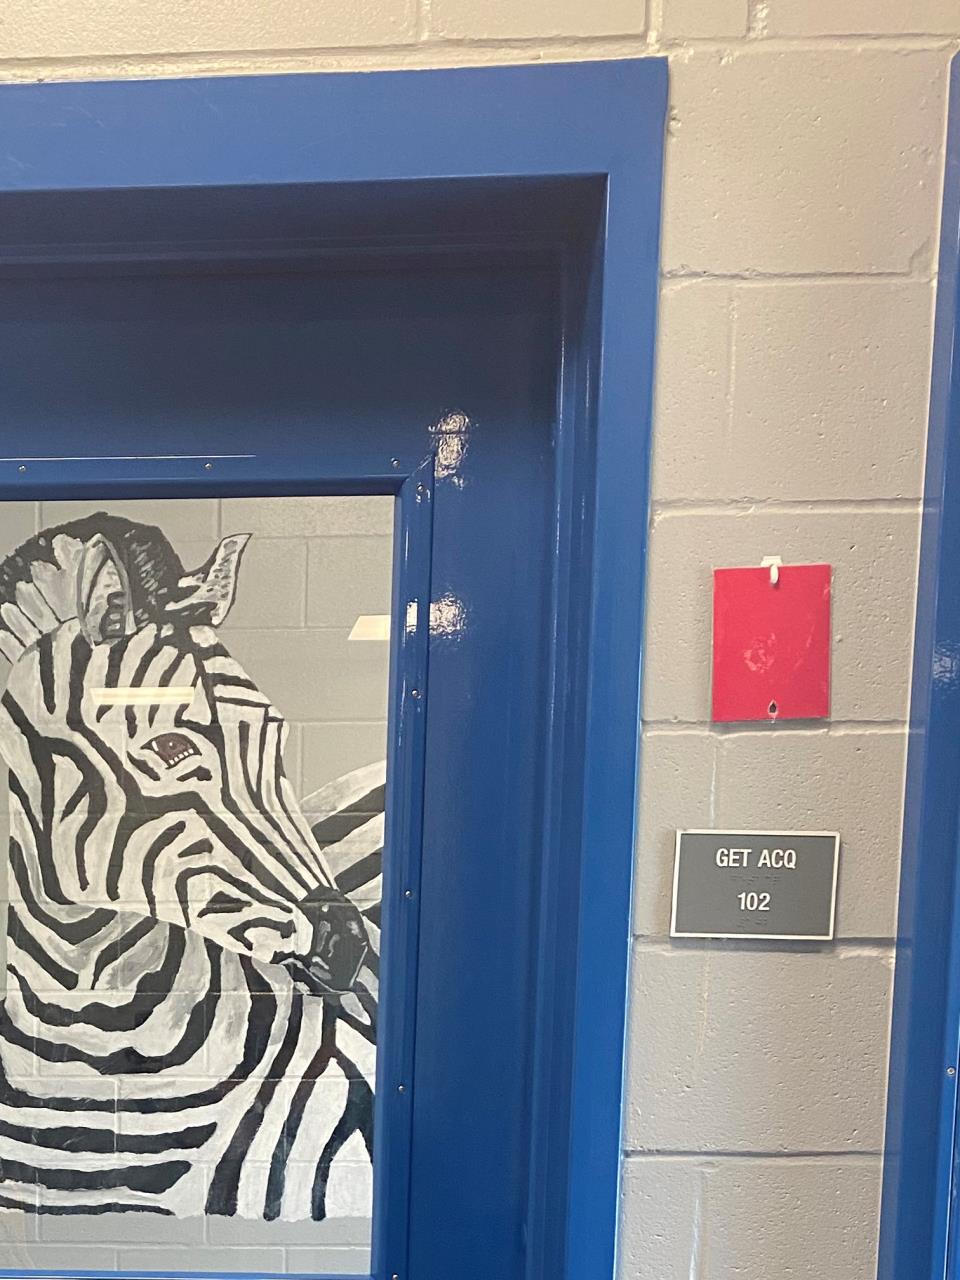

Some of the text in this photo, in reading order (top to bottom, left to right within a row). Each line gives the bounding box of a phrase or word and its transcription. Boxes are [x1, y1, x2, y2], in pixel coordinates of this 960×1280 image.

[715, 847, 797, 870] GET ACQ
[737, 891, 771, 911] 102
